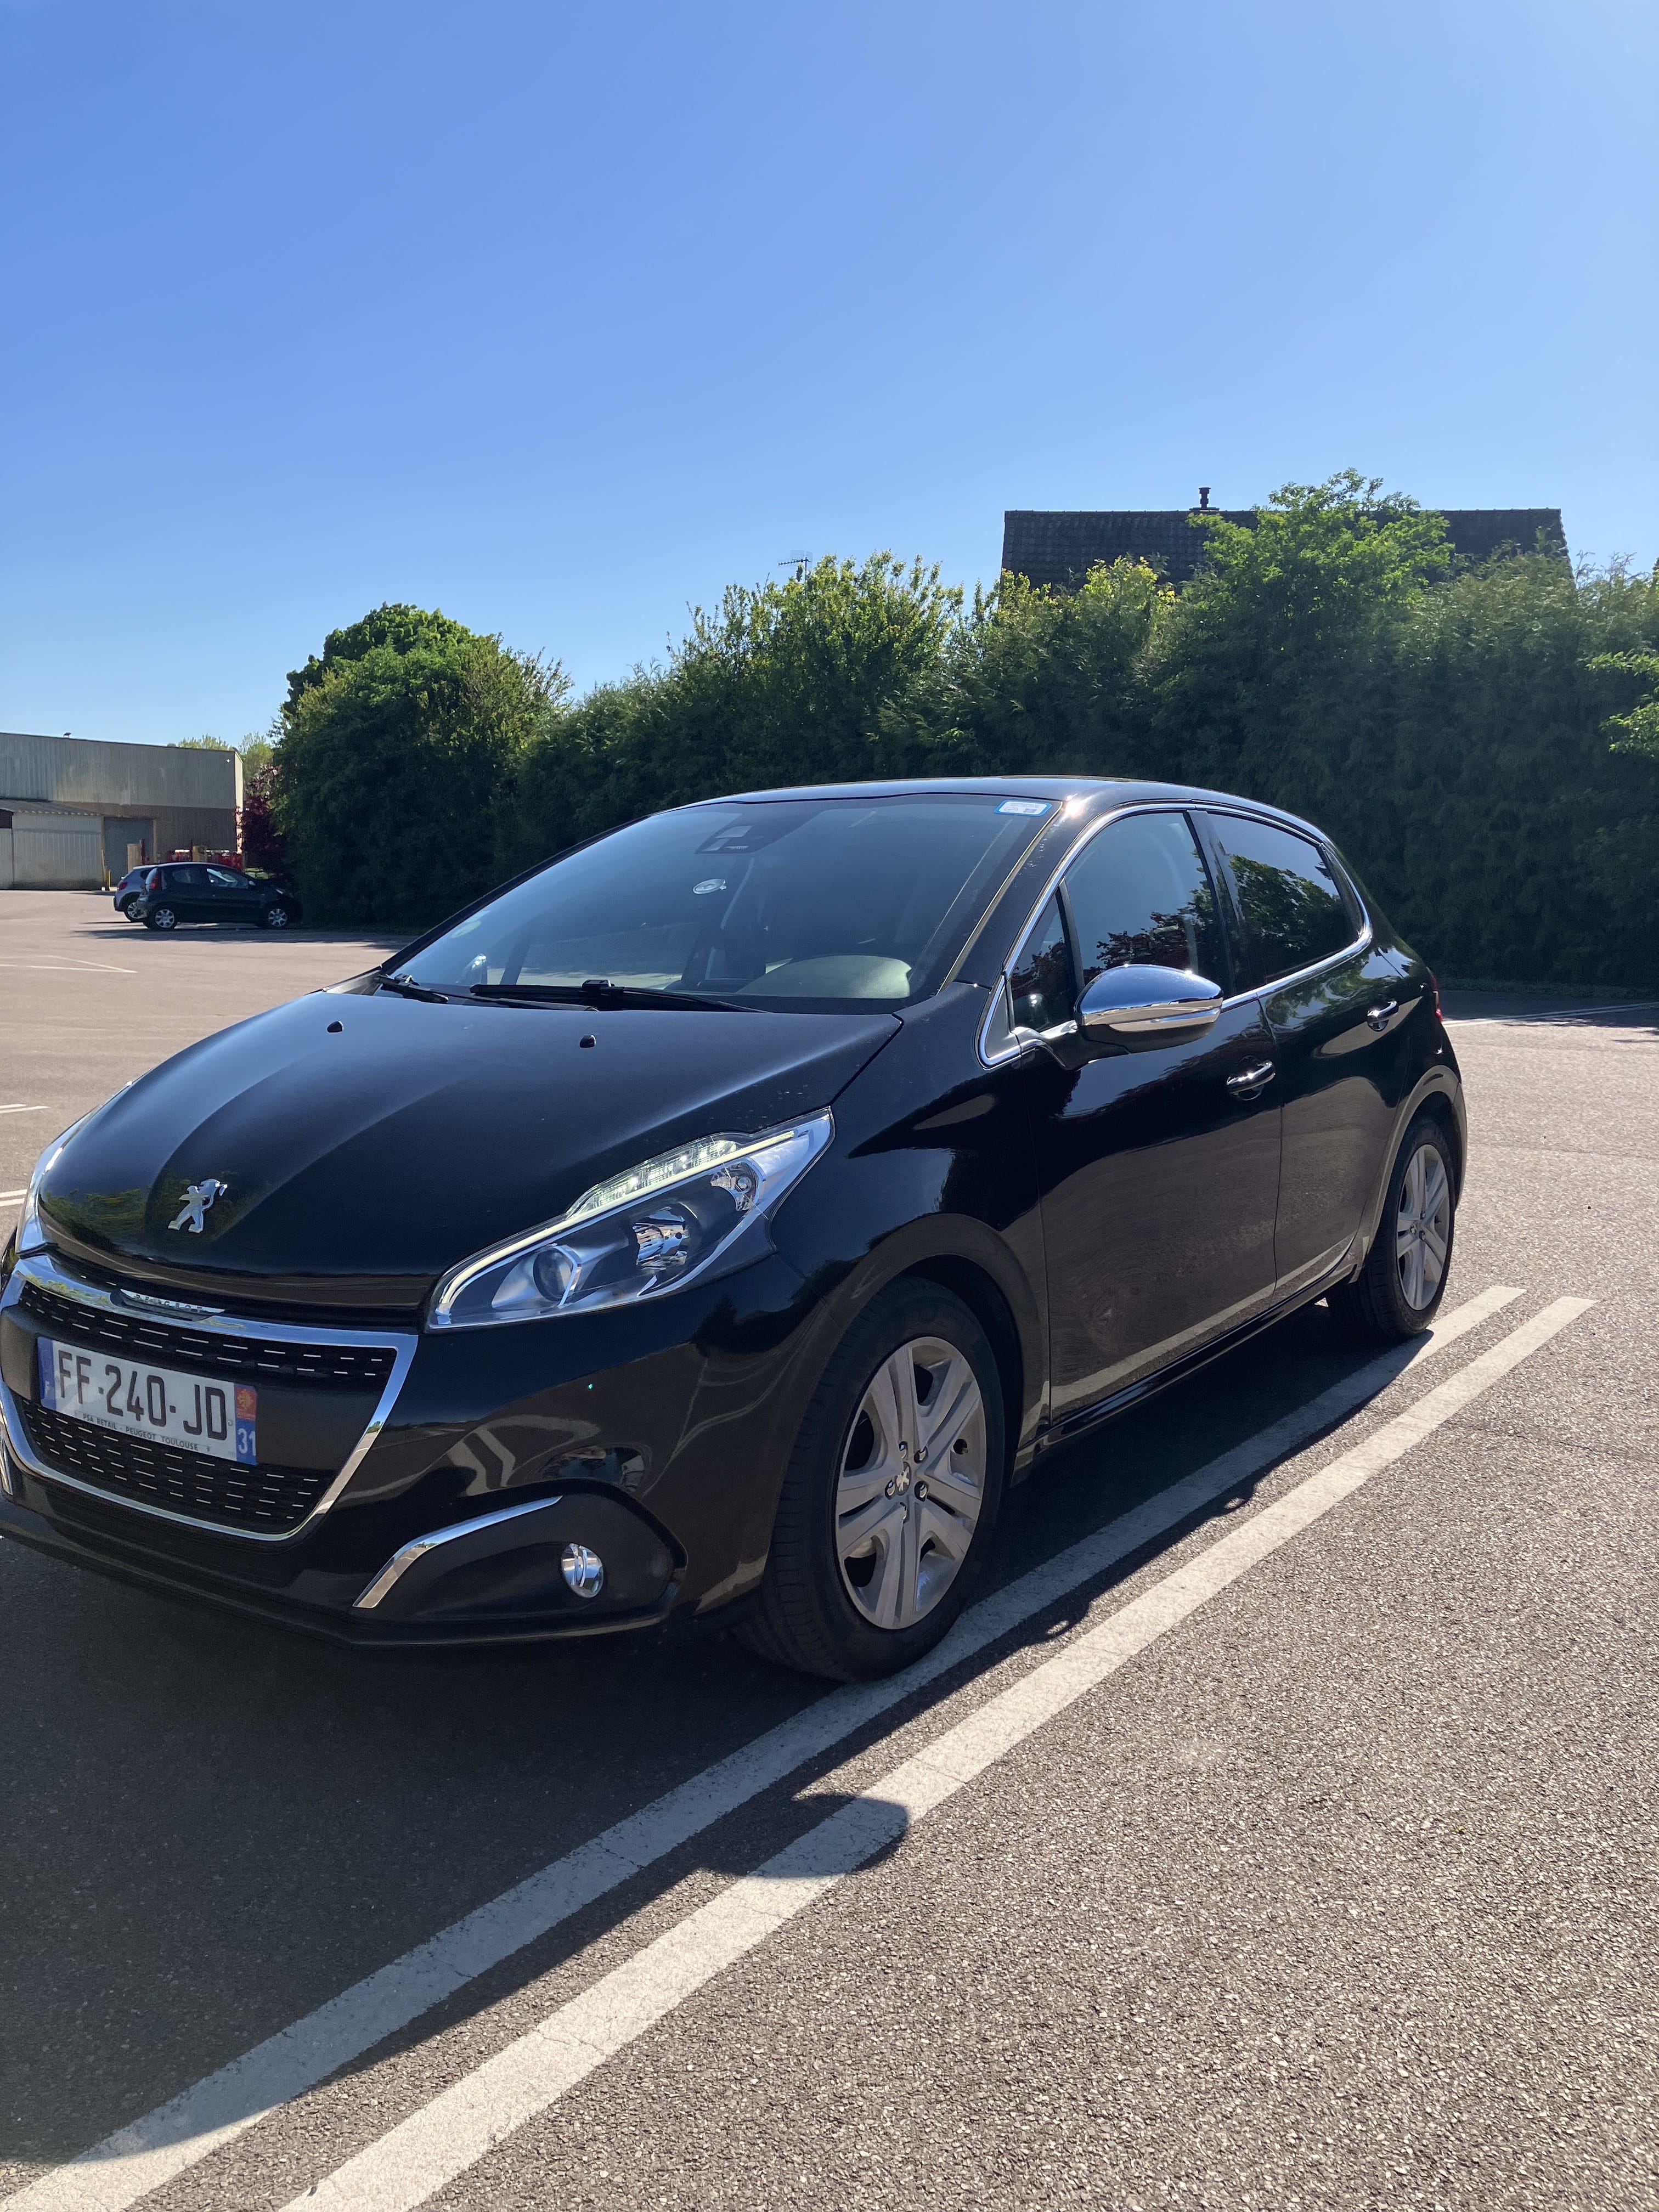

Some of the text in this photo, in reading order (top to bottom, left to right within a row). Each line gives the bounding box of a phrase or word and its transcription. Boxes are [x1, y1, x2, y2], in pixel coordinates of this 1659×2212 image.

[83, 1413, 94, 1423] PSA
[97, 1417, 117, 1430] RETAIL
[126, 1426, 156, 1440] PEUGEOT
[161, 1436, 198, 1451] TOULOUSE
[238, 1427, 256, 1456] 31
